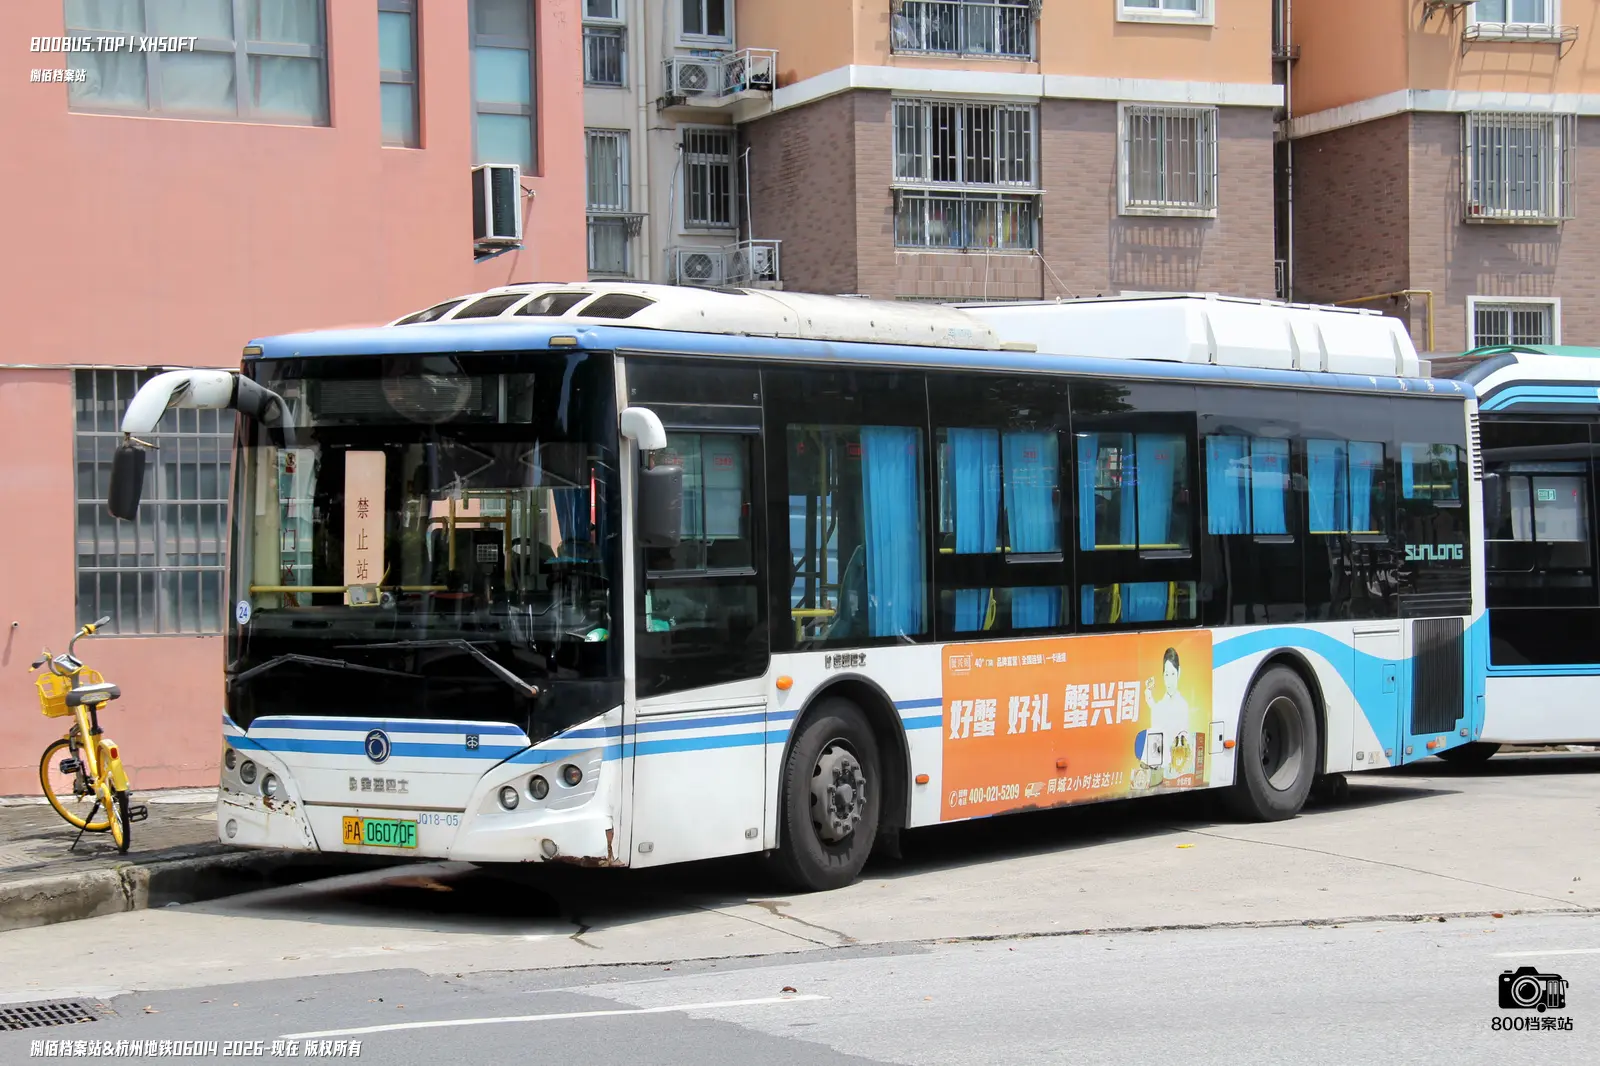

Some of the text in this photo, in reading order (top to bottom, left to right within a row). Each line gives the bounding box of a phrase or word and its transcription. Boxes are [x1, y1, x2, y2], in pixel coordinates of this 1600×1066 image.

[356, 497, 369, 581] 禁止站
[1404, 543, 1463, 560] SUNLONG
[238, 606, 248, 619] 24
[949, 680, 1141, 741] 好蟹 好礼 蟹兴阁
[969, 783, 1020, 804] 400-021-5209
[416, 813, 459, 827] JQ18-05
